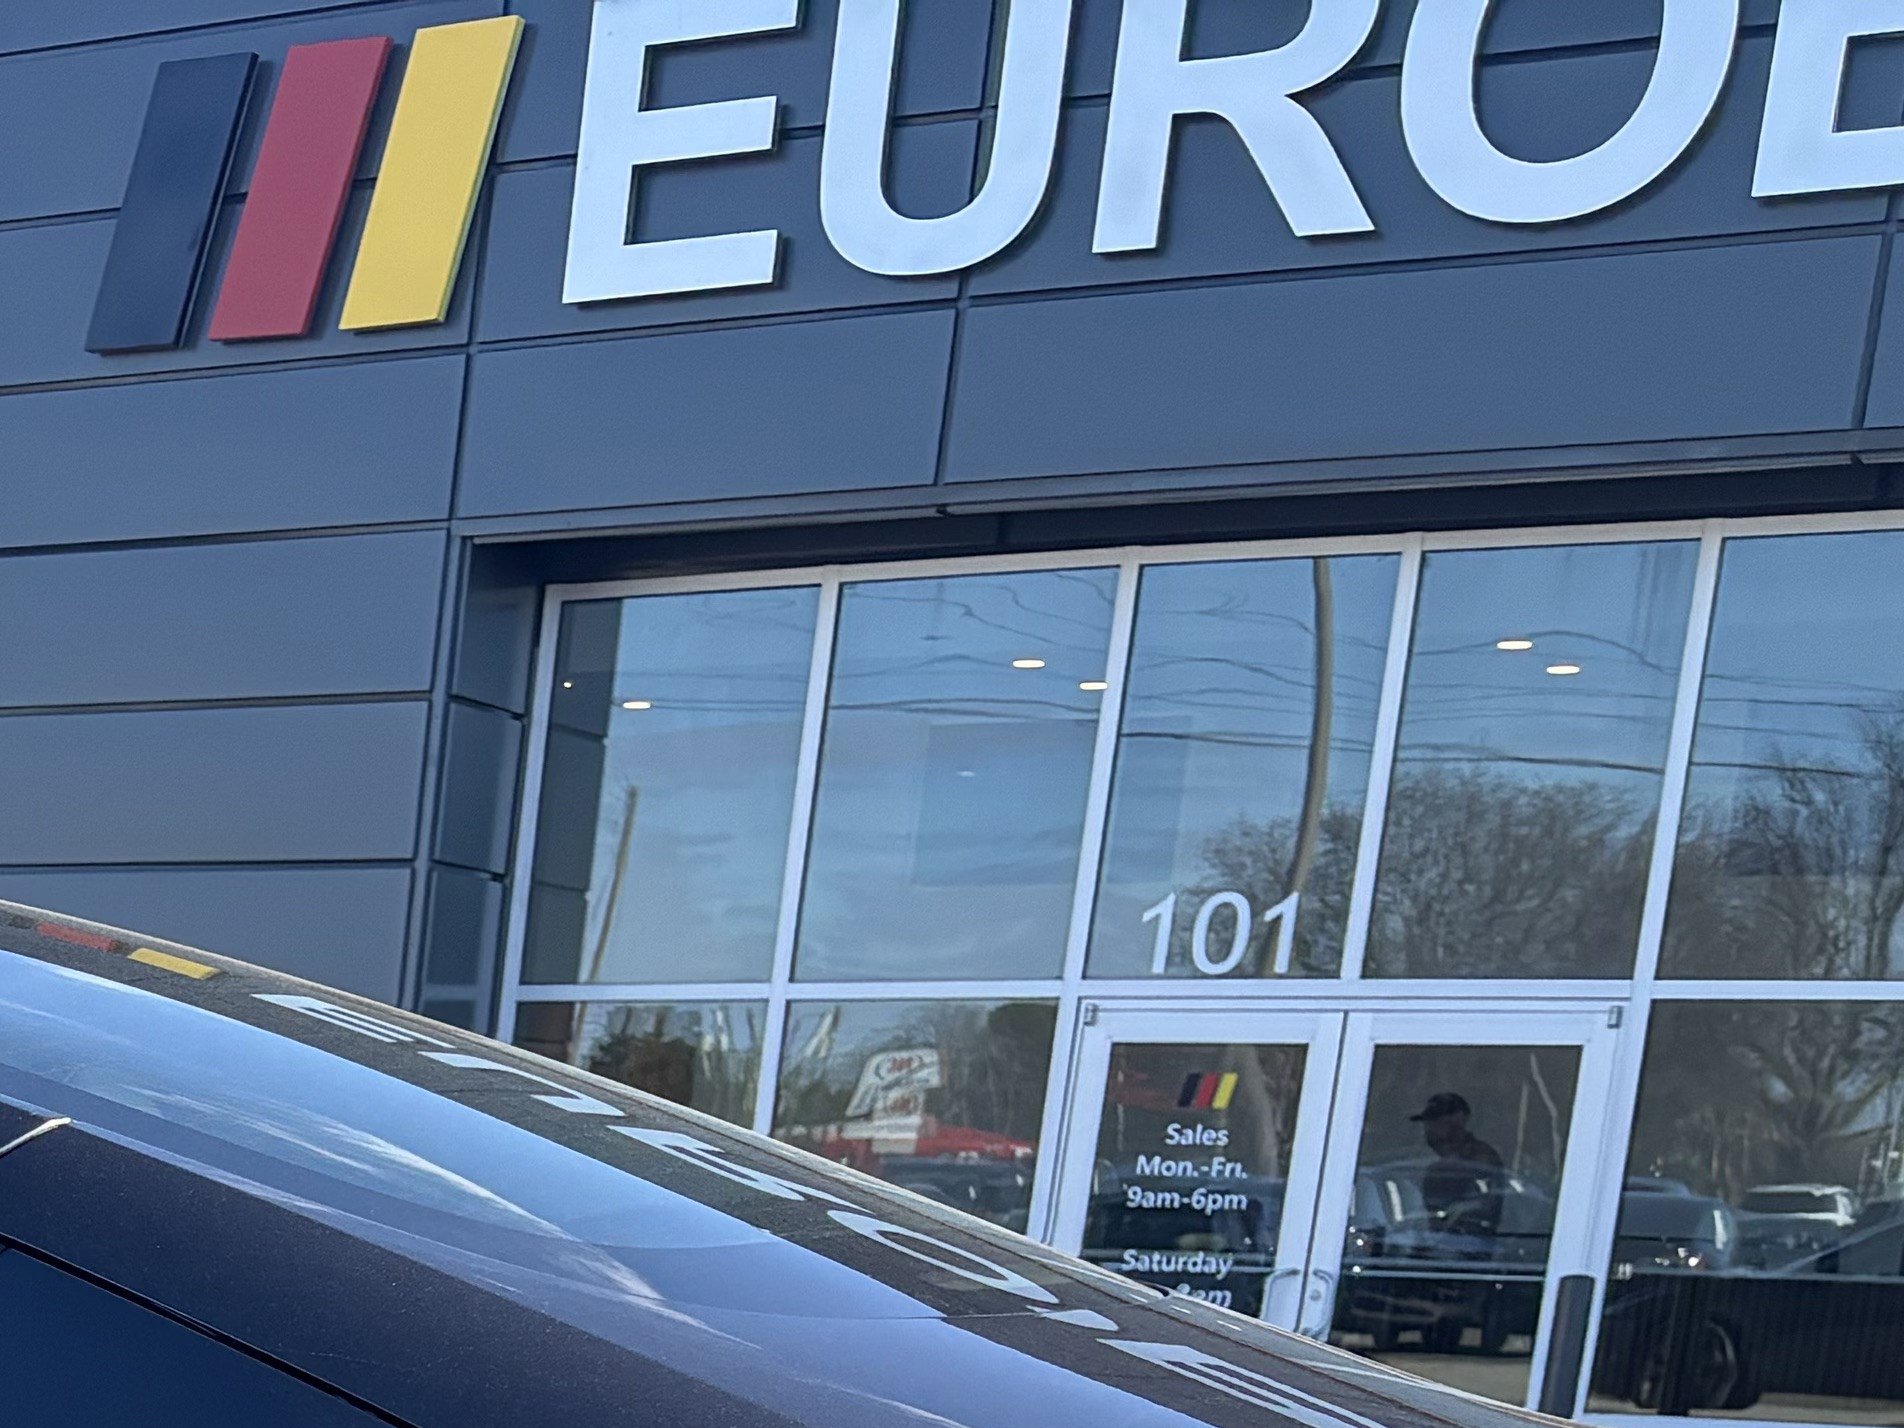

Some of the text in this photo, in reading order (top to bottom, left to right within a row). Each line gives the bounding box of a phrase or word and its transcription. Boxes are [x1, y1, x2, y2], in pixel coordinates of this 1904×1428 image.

[1142, 891, 1300, 976] 101
[1165, 1123, 1230, 1146] Sales
[1126, 1185, 1248, 1216] 9am-6pm
[1121, 1248, 1234, 1281] Saturday
